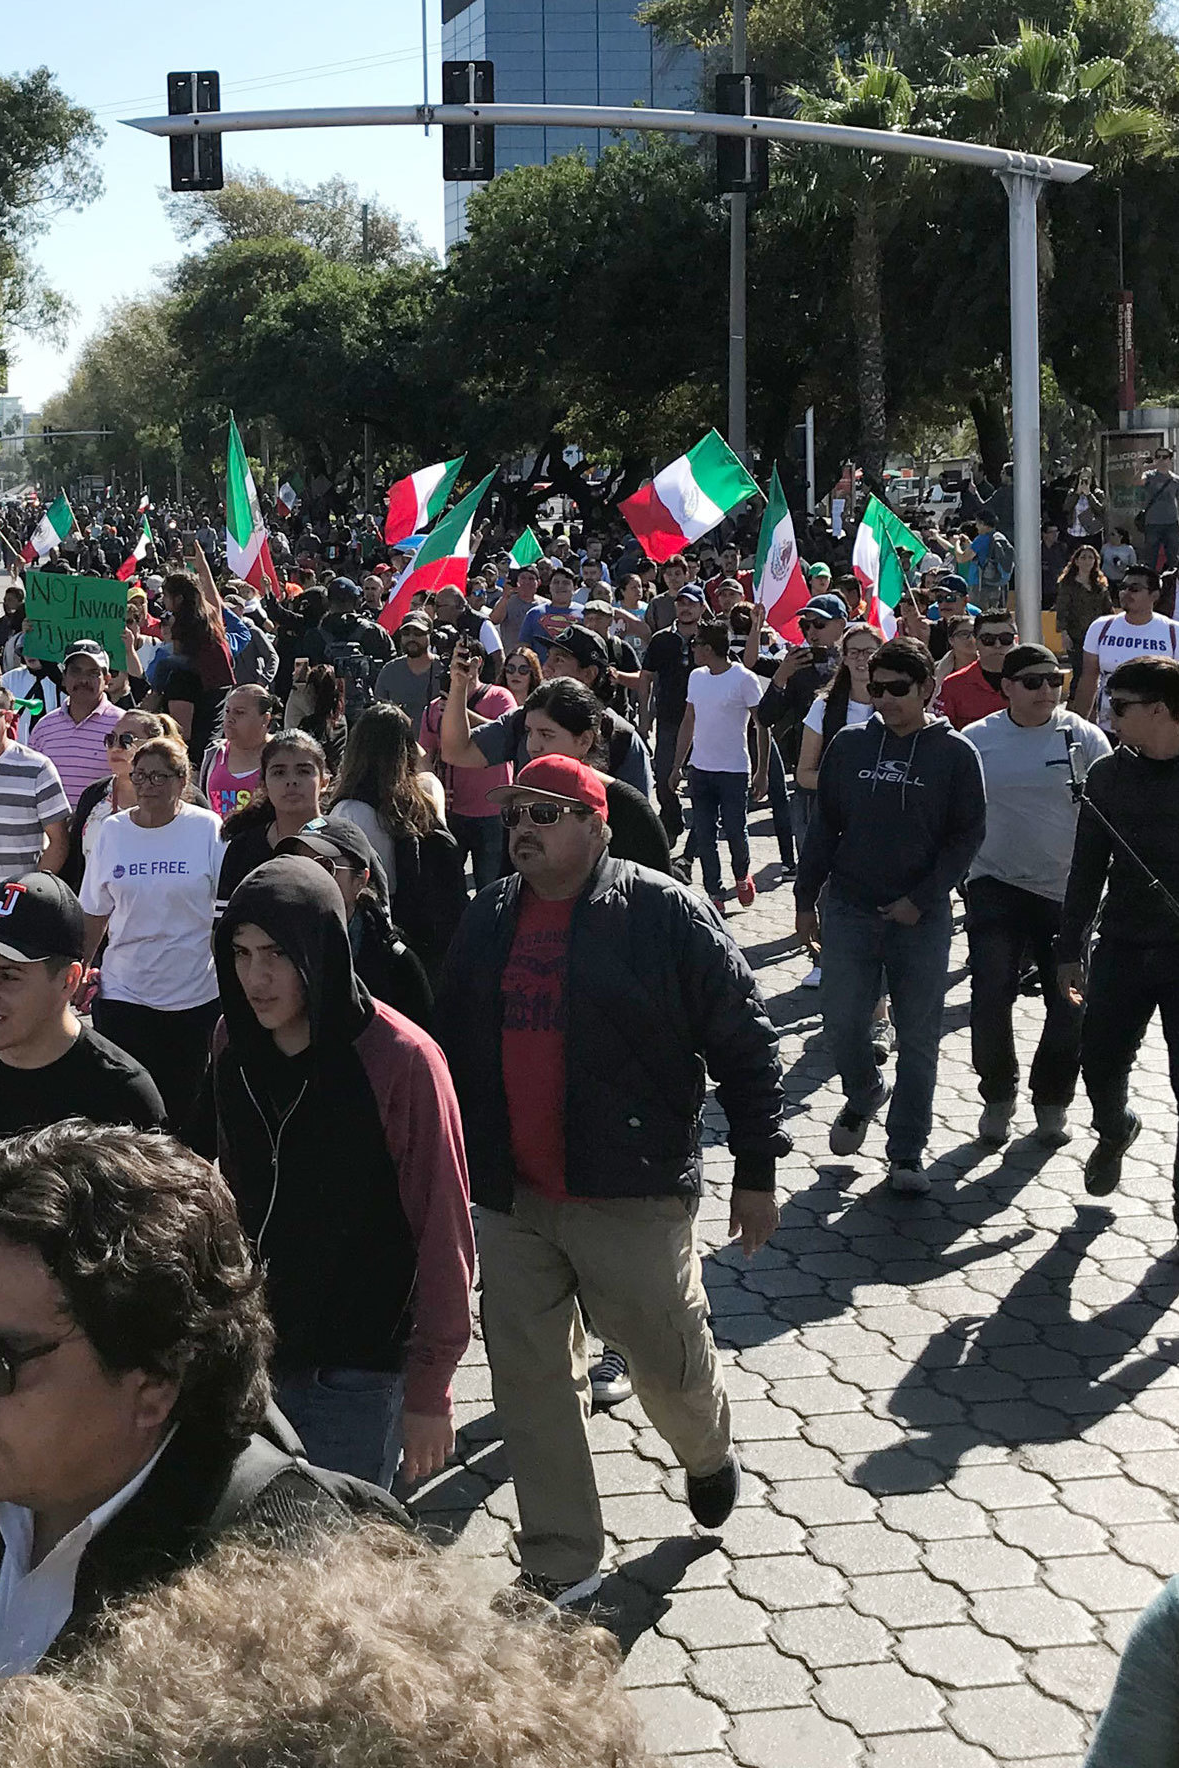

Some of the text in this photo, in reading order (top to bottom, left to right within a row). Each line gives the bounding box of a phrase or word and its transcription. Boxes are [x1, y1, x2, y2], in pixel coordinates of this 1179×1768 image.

[32, 575, 68, 605] NO
[129, 861, 190, 876] BE FREE.
